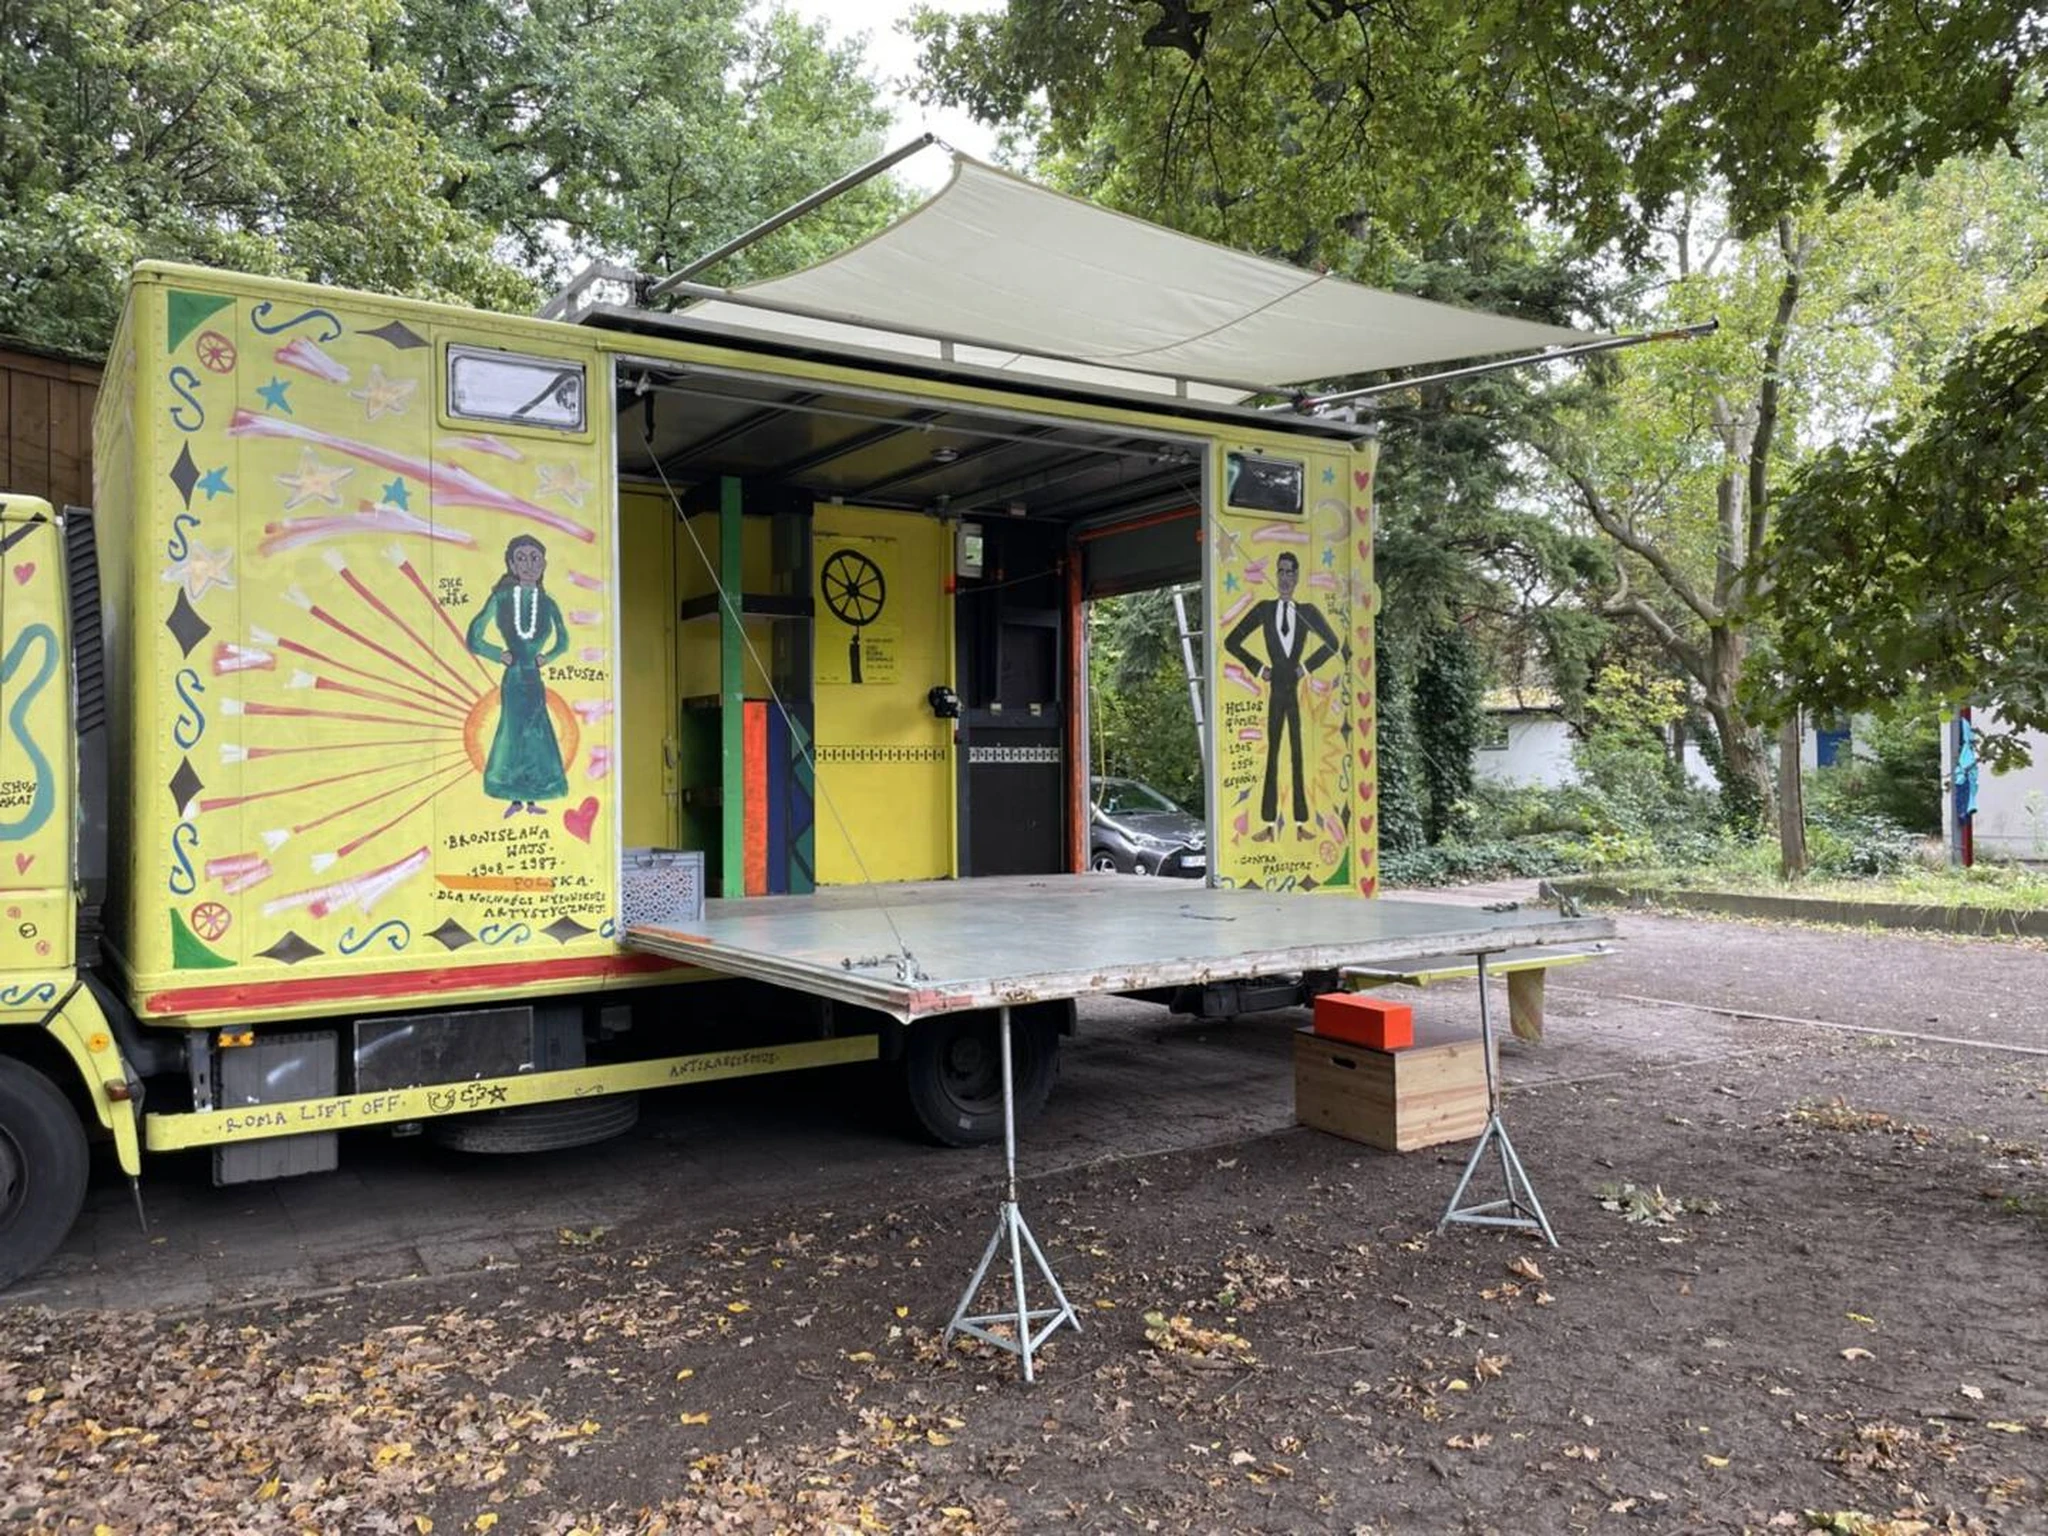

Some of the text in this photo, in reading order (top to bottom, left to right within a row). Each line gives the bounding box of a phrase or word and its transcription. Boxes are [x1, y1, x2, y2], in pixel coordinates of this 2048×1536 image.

[548, 665, 605, 682] PAPUSZA
[226, 1111, 287, 1133] ROMA
[300, 1100, 350, 1120] LIFT
